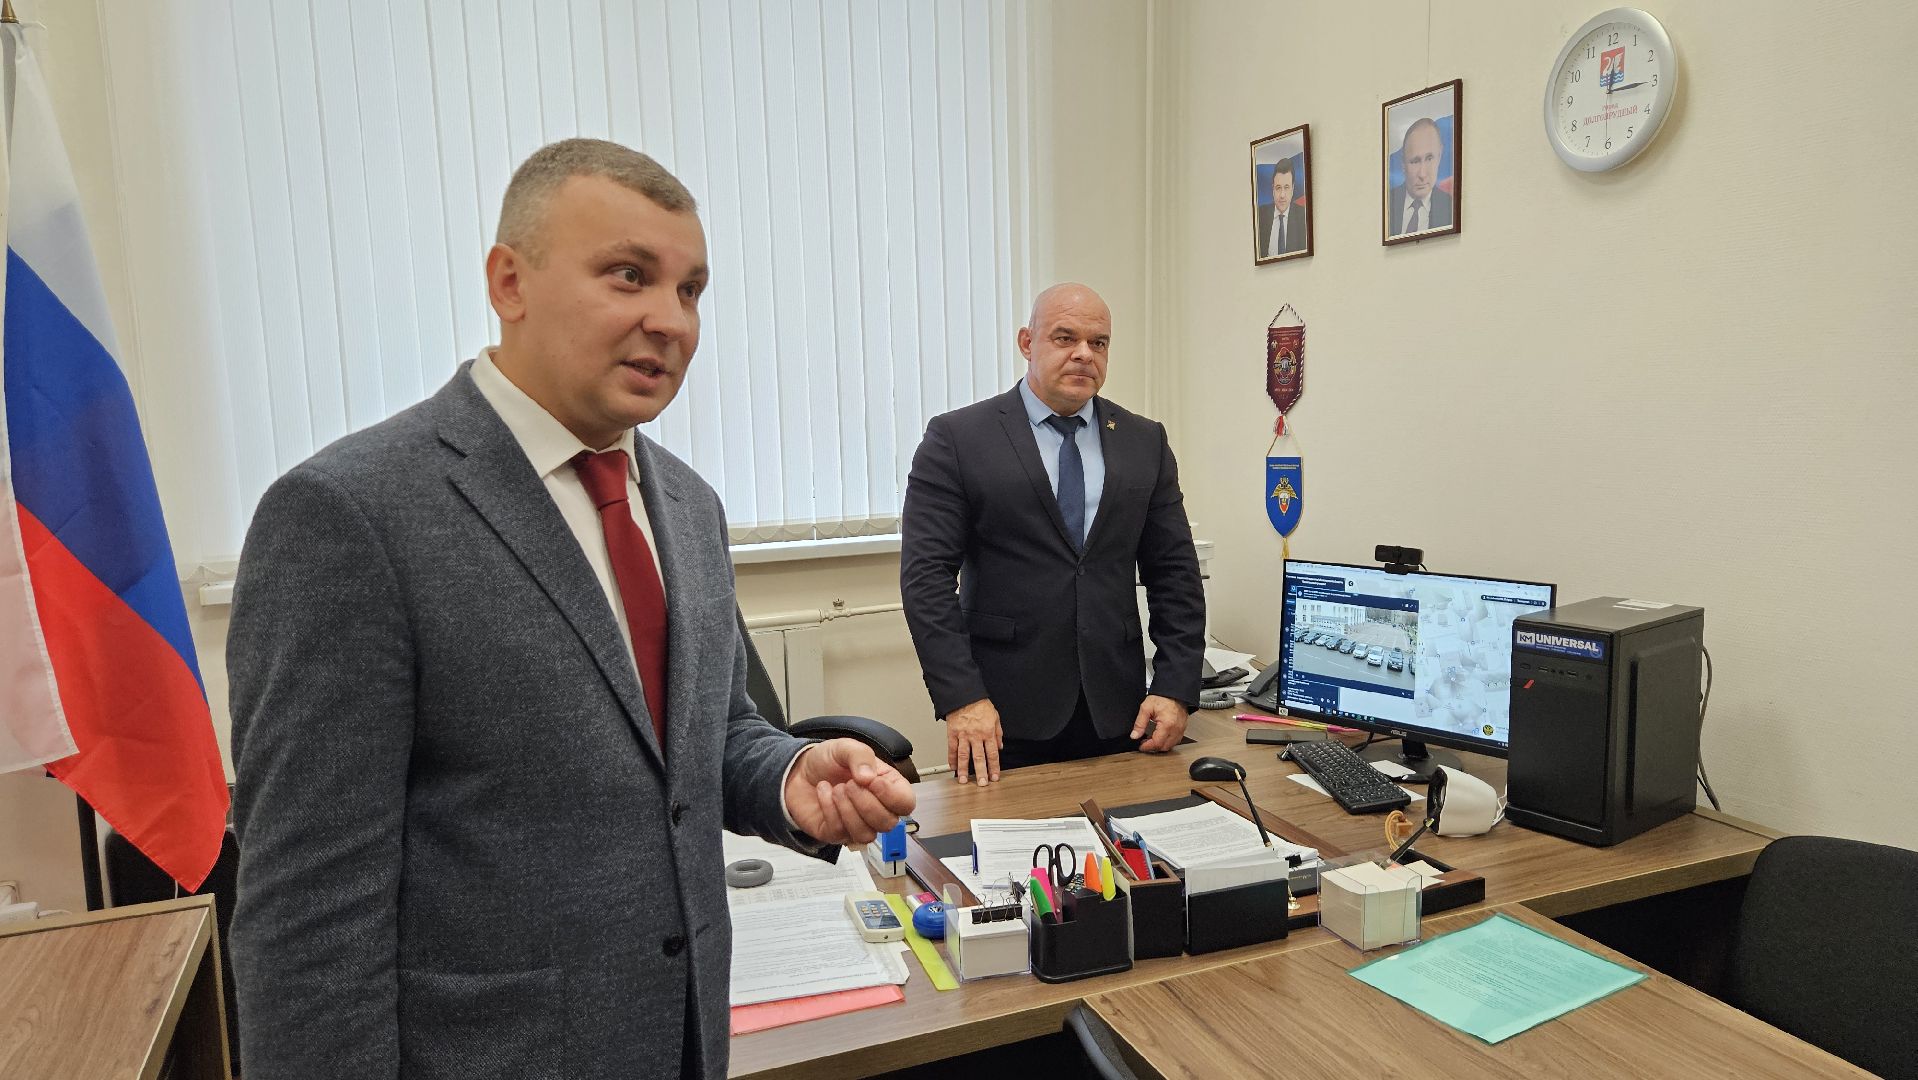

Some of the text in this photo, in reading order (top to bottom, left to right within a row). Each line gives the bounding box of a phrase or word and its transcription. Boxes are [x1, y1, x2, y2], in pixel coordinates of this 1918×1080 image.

[1607, 32, 1619, 46] 12
[1633, 34, 1638, 46] 1
[1586, 46, 1595, 59] 11
[1647, 50, 1654, 62] 2
[1570, 69, 1581, 83] 10
[1651, 75, 1658, 87] 3
[1567, 96, 1573, 108] 9
[1643, 103, 1651, 114] 4
[1571, 120, 1577, 132] 8
[1626, 126, 1634, 139] 5
[1585, 135, 1591, 148] 7
[1604, 138, 1612, 149] 6
[1535, 633, 1599, 652] UNIVERSAL
